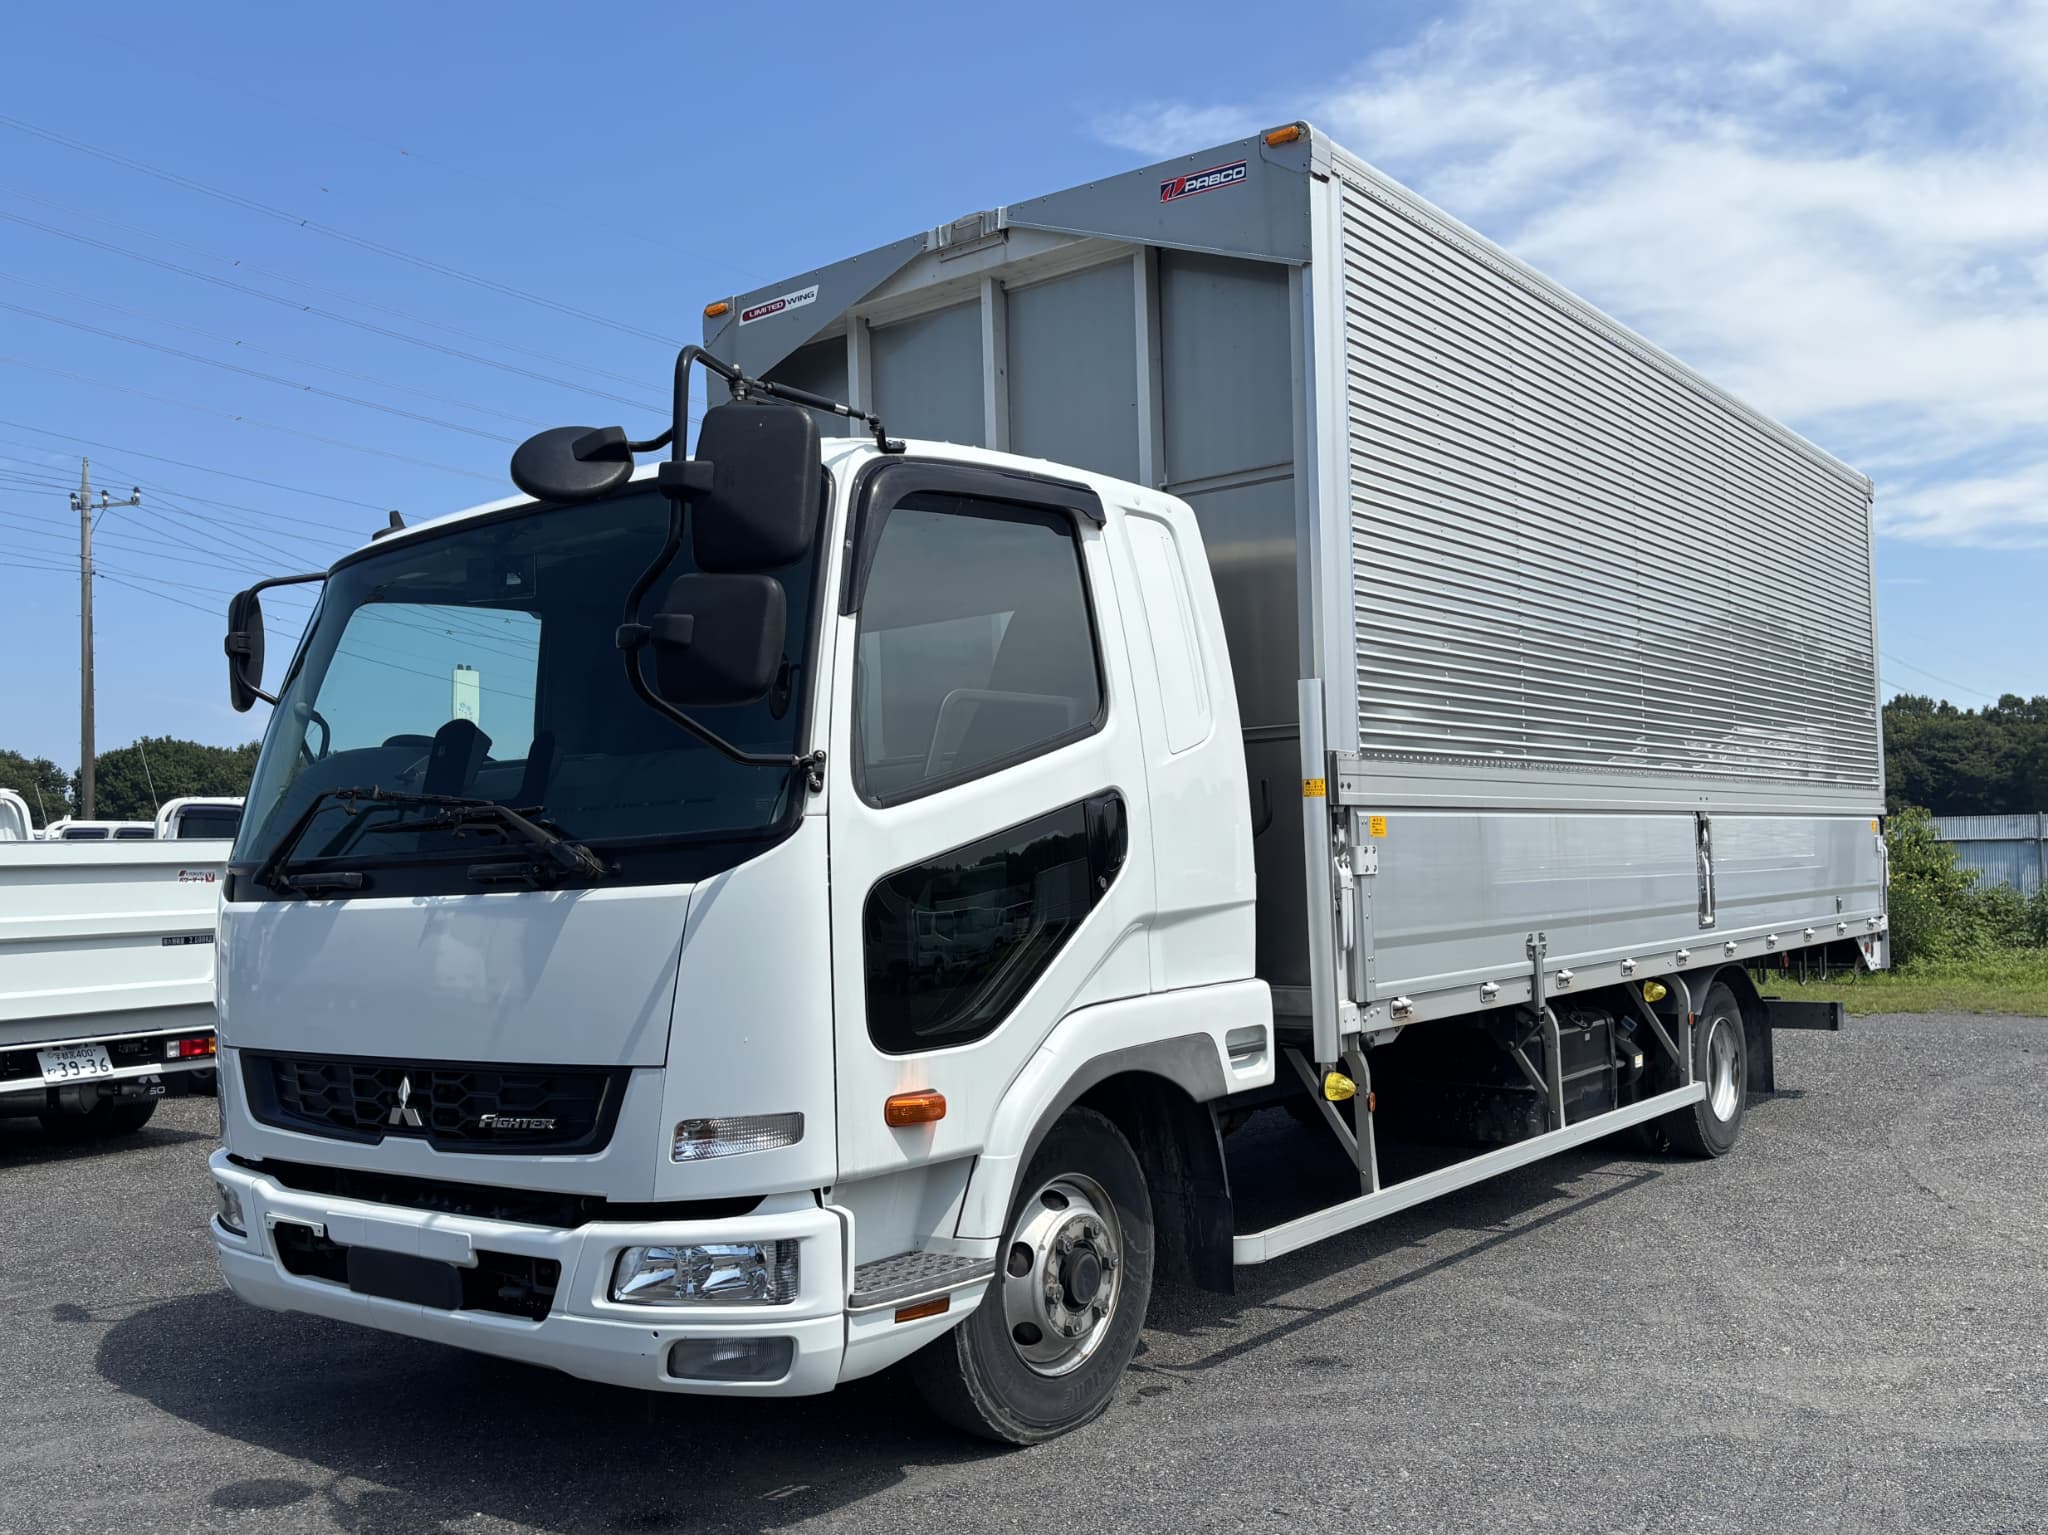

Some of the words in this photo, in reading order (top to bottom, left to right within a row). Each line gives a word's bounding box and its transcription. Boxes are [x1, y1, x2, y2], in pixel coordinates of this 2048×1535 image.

[1185, 167, 1245, 192] PABCO
[749, 302, 783, 317] LIMITED
[787, 291, 814, 304] WING
[56, 1057, 109, 1077] 39-36
[479, 1114, 556, 1129] FIGHTER
